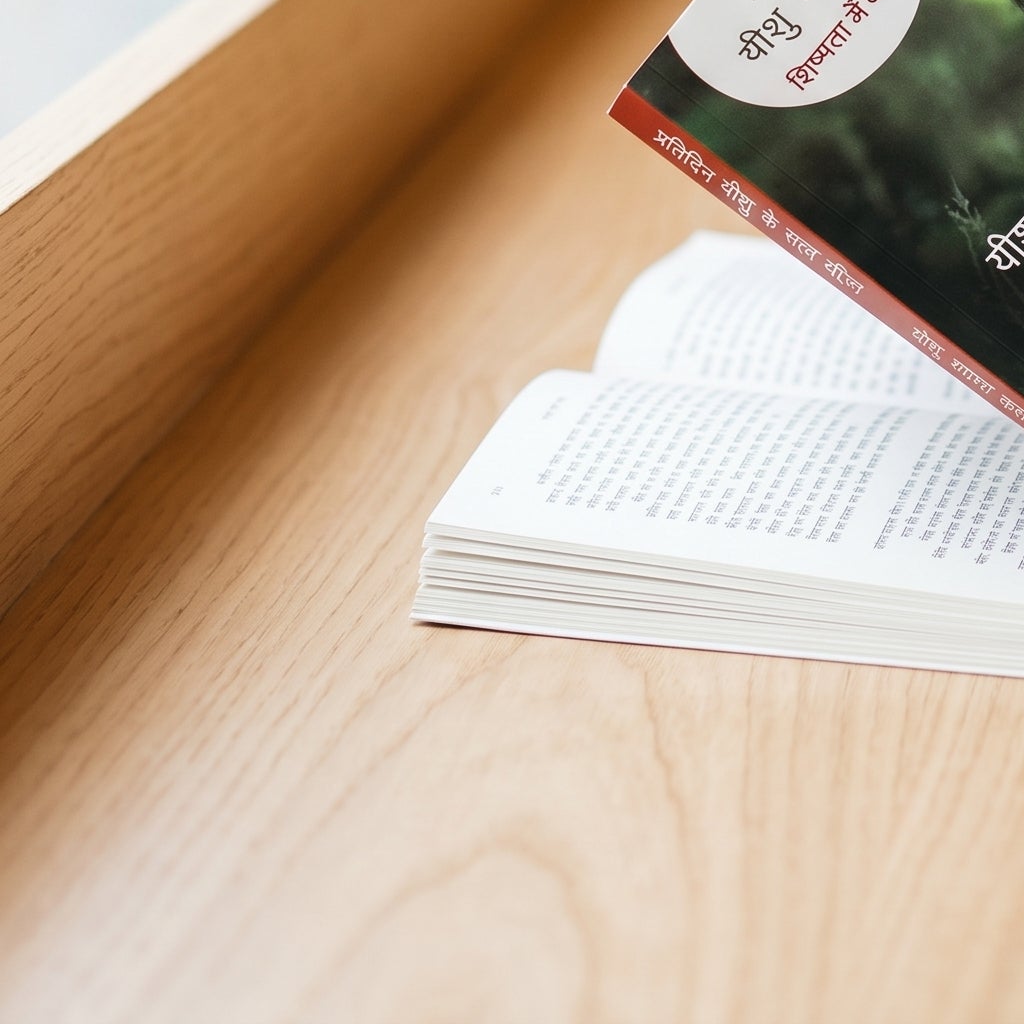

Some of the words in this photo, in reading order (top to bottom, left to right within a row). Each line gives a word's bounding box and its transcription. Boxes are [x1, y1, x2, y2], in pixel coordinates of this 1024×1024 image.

[738, 7, 803, 61] यीशु
[785, 20, 852, 91] शिष्यता
[652, 129, 717, 183] प्रतिदिन
[720, 178, 757, 218] यीशु
[761, 208, 780, 230] के
